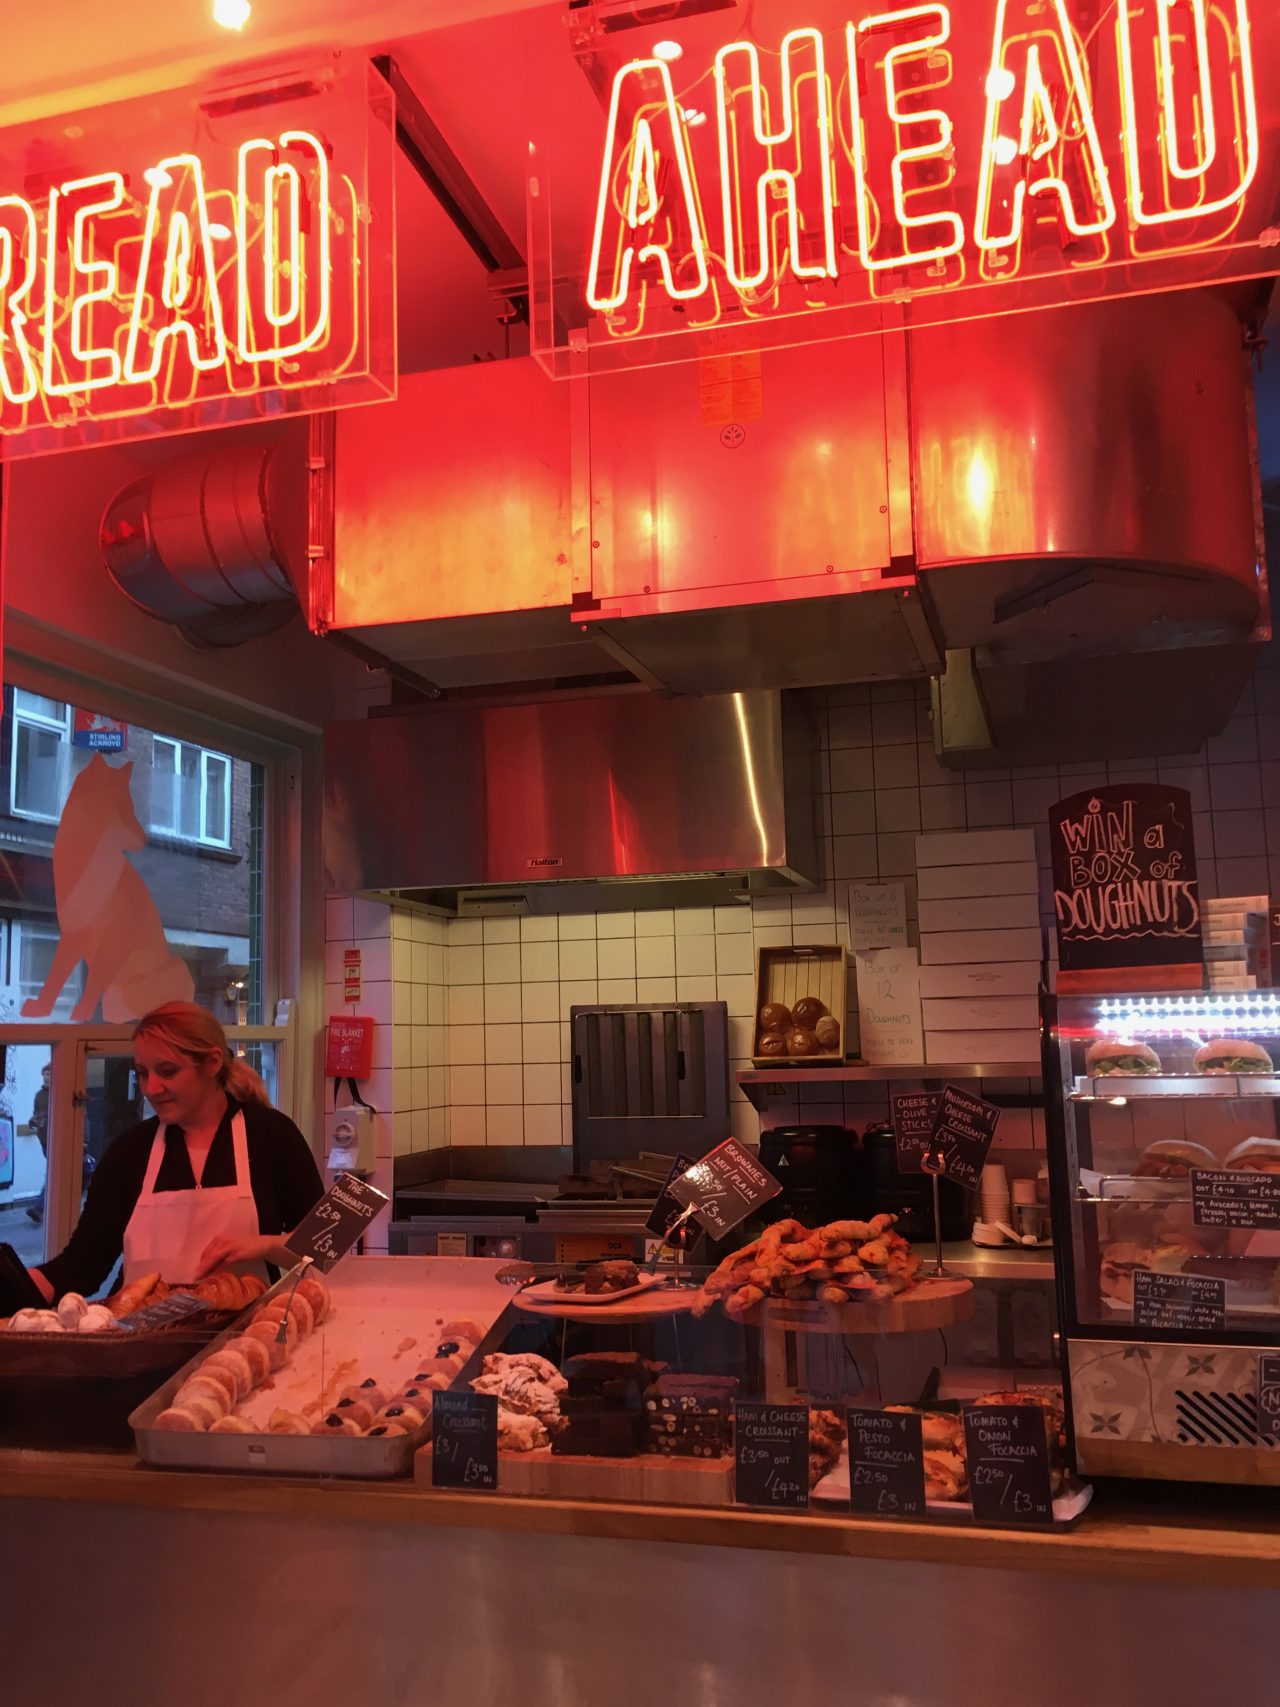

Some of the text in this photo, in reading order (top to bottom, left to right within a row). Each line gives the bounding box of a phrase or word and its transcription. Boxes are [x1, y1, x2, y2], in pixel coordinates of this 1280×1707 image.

[587, 0, 1260, 310] AHEAD
[1143, 824, 1165, 849] a
[530, 858, 559, 867] Halton
[1069, 850, 1182, 889] BOX of
[1054, 878, 1199, 934] DOUGHNUTS
[876, 980, 895, 1000] 12
[342, 1027, 364, 1038] BLANKET
[897, 1097, 929, 1109] CHEESE
[901, 1118, 934, 1131] STICKS
[948, 1117, 988, 1143] CROISSANT
[724, 1143, 768, 1188] BROWNIES
[969, 1176, 978, 1184] IN
[1196, 1172, 1227, 1181] BACON
[1236, 1175, 1273, 1184] AVOCADO
[330, 1186, 374, 1218] DOUGHNUTS
[700, 1200, 720, 1218] £3
[714, 1216, 726, 1227] IN
[313, 1233, 333, 1252] £3
[326, 1249, 338, 1259] IN
[1155, 1275, 1180, 1287] SALAD
[1186, 1278, 1220, 1291] FOCACCIA
[435, 1395, 469, 1412] Almond
[442, 1413, 489, 1430] Croissant
[737, 1407, 758, 1422] HAM
[769, 1410, 807, 1422] CHEESE
[850, 1413, 893, 1429] TOMATO
[964, 1411, 1008, 1428] TOMATO
[858, 1429, 891, 1444] PESTO
[978, 1429, 1012, 1441] ONION
[864, 1446, 916, 1463] FOCACCIA
[987, 1442, 1038, 1457] FOCACCIA
[774, 1456, 792, 1465] OUT
[877, 1489, 917, 1511] £3 IN
[1012, 1490, 1033, 1513] £3
[1036, 1504, 1047, 1512] IN
